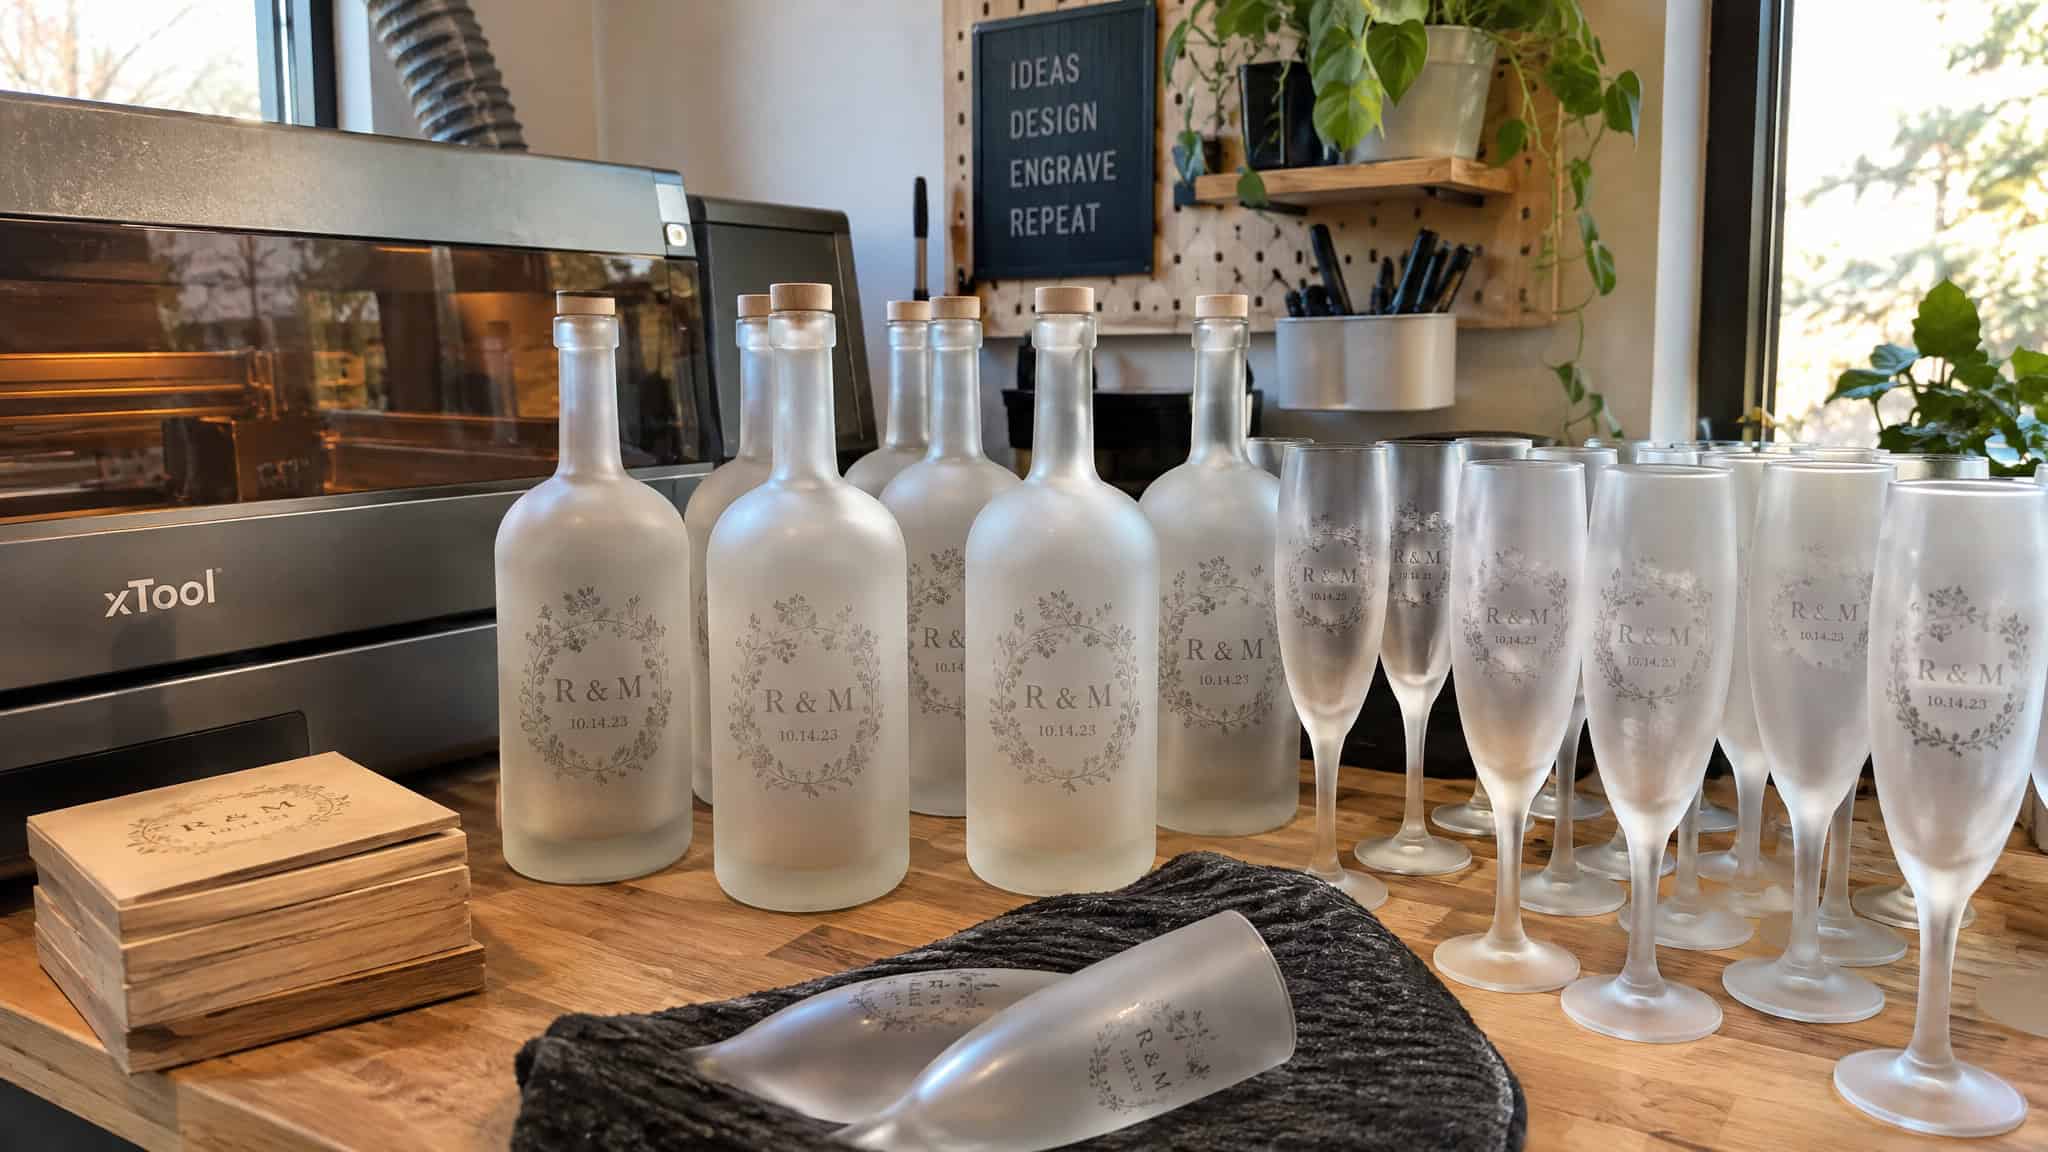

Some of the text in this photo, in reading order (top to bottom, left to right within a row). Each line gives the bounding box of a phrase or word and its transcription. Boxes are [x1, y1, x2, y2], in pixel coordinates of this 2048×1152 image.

[1010, 53, 1081, 91] IDEAS
[1010, 102, 1098, 139] DESIGN
[1010, 151, 1117, 188] ENGRAVE
[1010, 203, 1101, 237] REPEAT
[1303, 567, 1315, 583] R
[1341, 567, 1357, 584] M
[103, 568, 216, 618] xTool
[1487, 607, 1500, 625] R
[1530, 608, 1548, 625] M
[1792, 600, 1808, 620] R
[1838, 603, 1858, 622] M
[923, 627, 966, 649] R &
[1618, 623, 1634, 644] R
[1668, 626, 1690, 647] M
[1186, 638, 1264, 661] R & M
[1919, 658, 2004, 686] R & M
[554, 675, 642, 703] R & M
[764, 687, 855, 713] R & M
[1025, 684, 1113, 710] R & M
[1136, 1027, 1153, 1049] R
[1151, 1071, 1172, 1092] M
